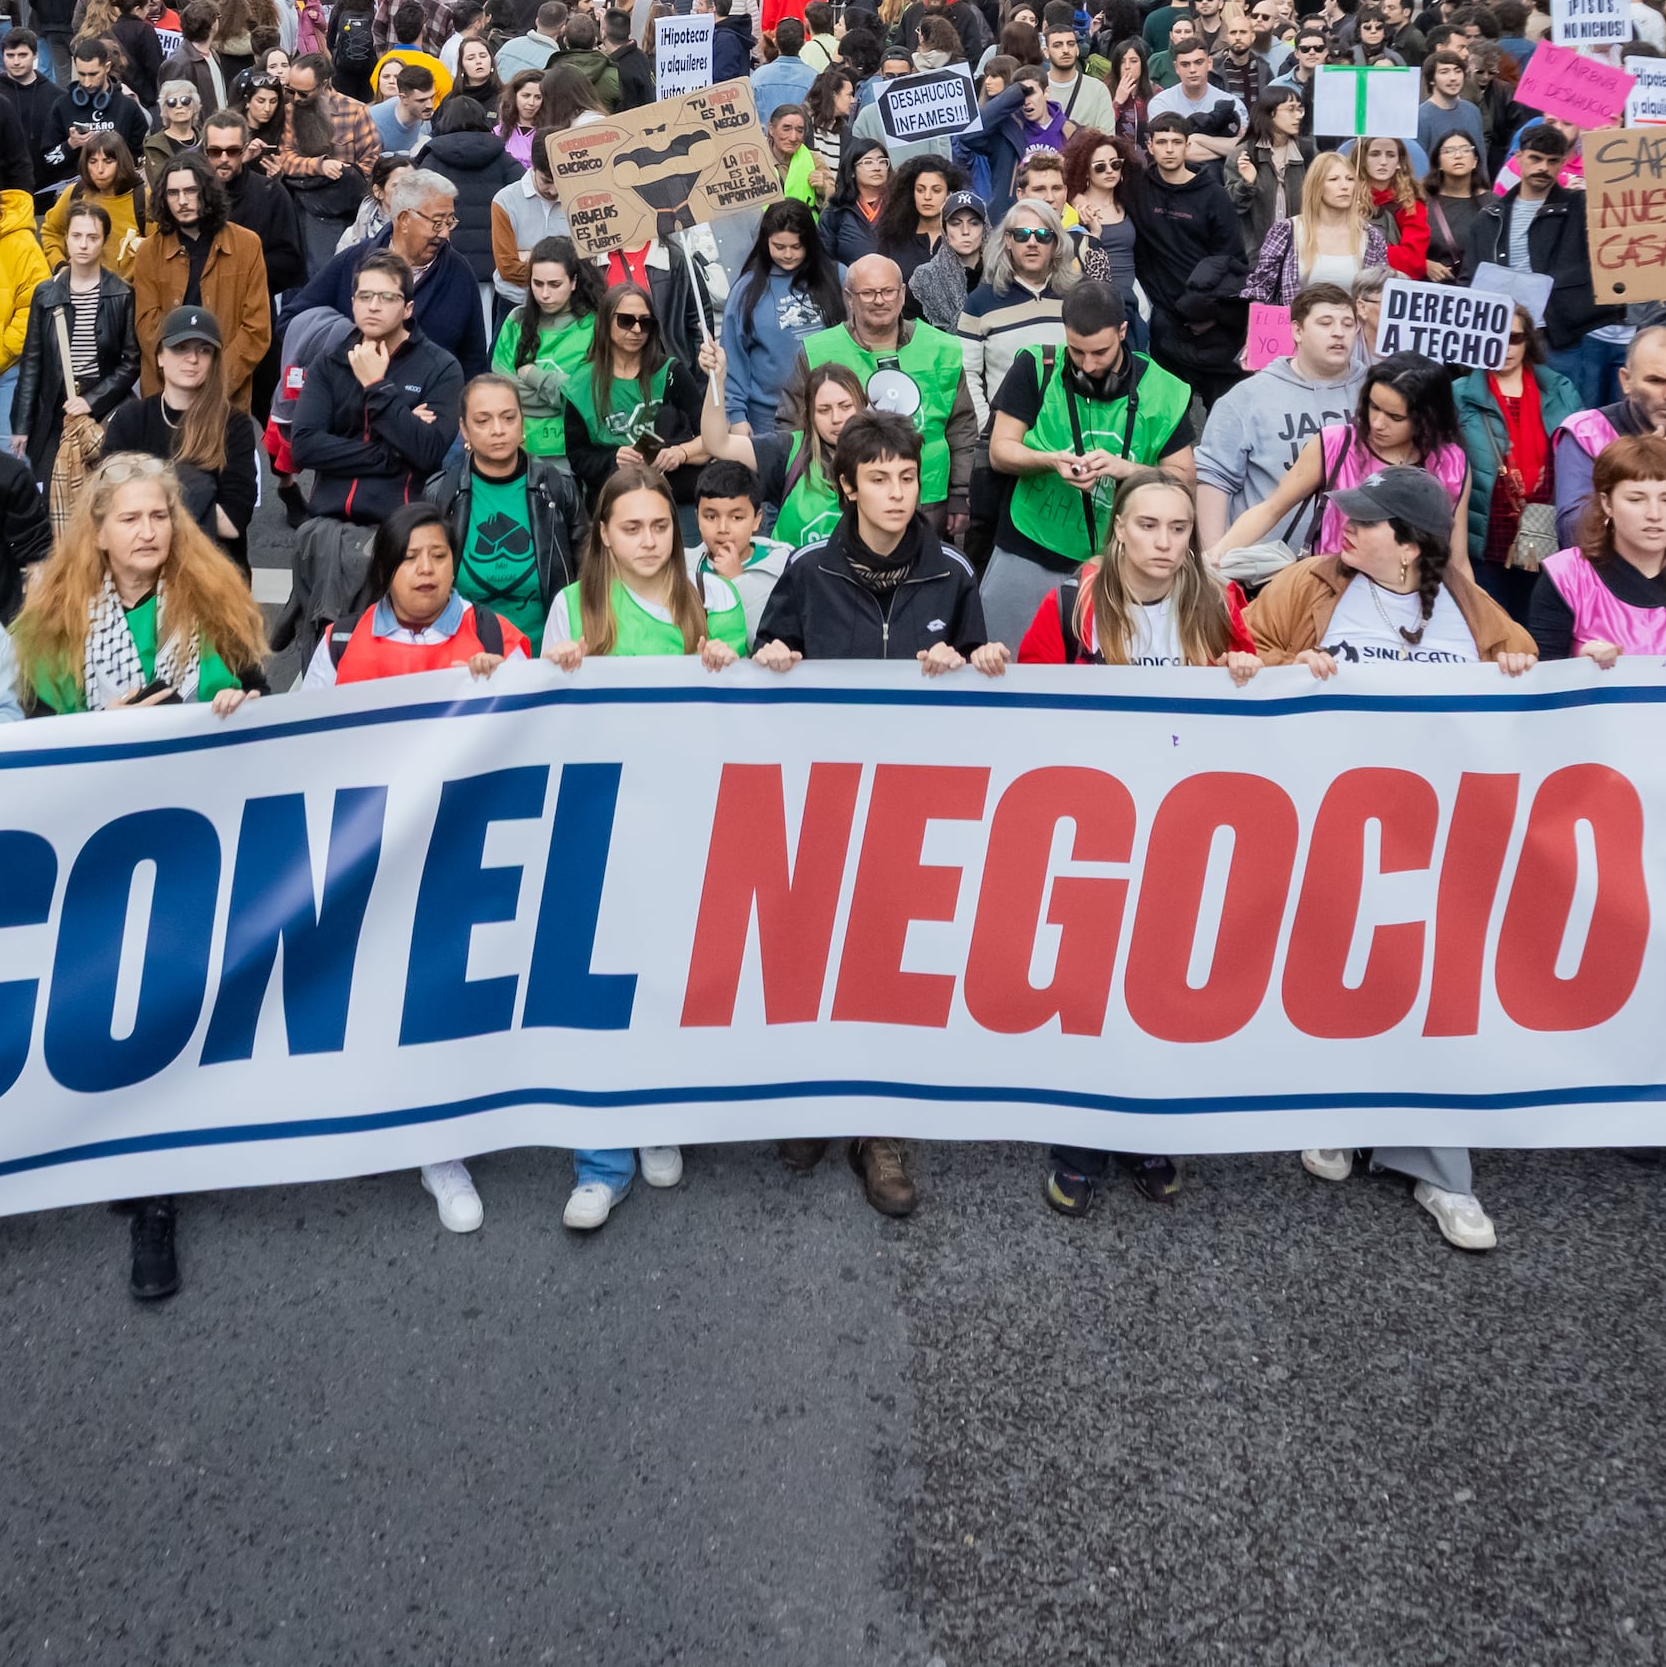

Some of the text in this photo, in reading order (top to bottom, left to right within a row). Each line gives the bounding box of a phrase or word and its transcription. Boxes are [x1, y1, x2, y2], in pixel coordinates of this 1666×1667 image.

[661, 28, 709, 49] ¡Hipotecas
[1563, 20, 1626, 38] NO NICHOS!
[661, 54, 708, 78] y alquileres
[687, 98, 707, 111] TU
[890, 80, 964, 110] DESAHUCIOS
[701, 104, 736, 120] ES MI
[714, 112, 750, 132] NEGOCIO
[895, 104, 969, 133] INFAMES!!!
[569, 149, 589, 161] POR
[723, 149, 759, 169] LA LEY
[557, 157, 603, 176] ENCARGO
[728, 164, 761, 179] ES UN
[705, 174, 767, 196] DETALLE SIN
[717, 182, 778, 206] IMPORTANCIA
[570, 205, 619, 227] ABUELAS
[575, 221, 608, 240] ES MI
[1388, 289, 1509, 334] DERECHO
[1381, 325, 1507, 368] A TECHO
[399, 763, 639, 1046] EL
[681, 763, 1649, 1042] NEGOCIO
